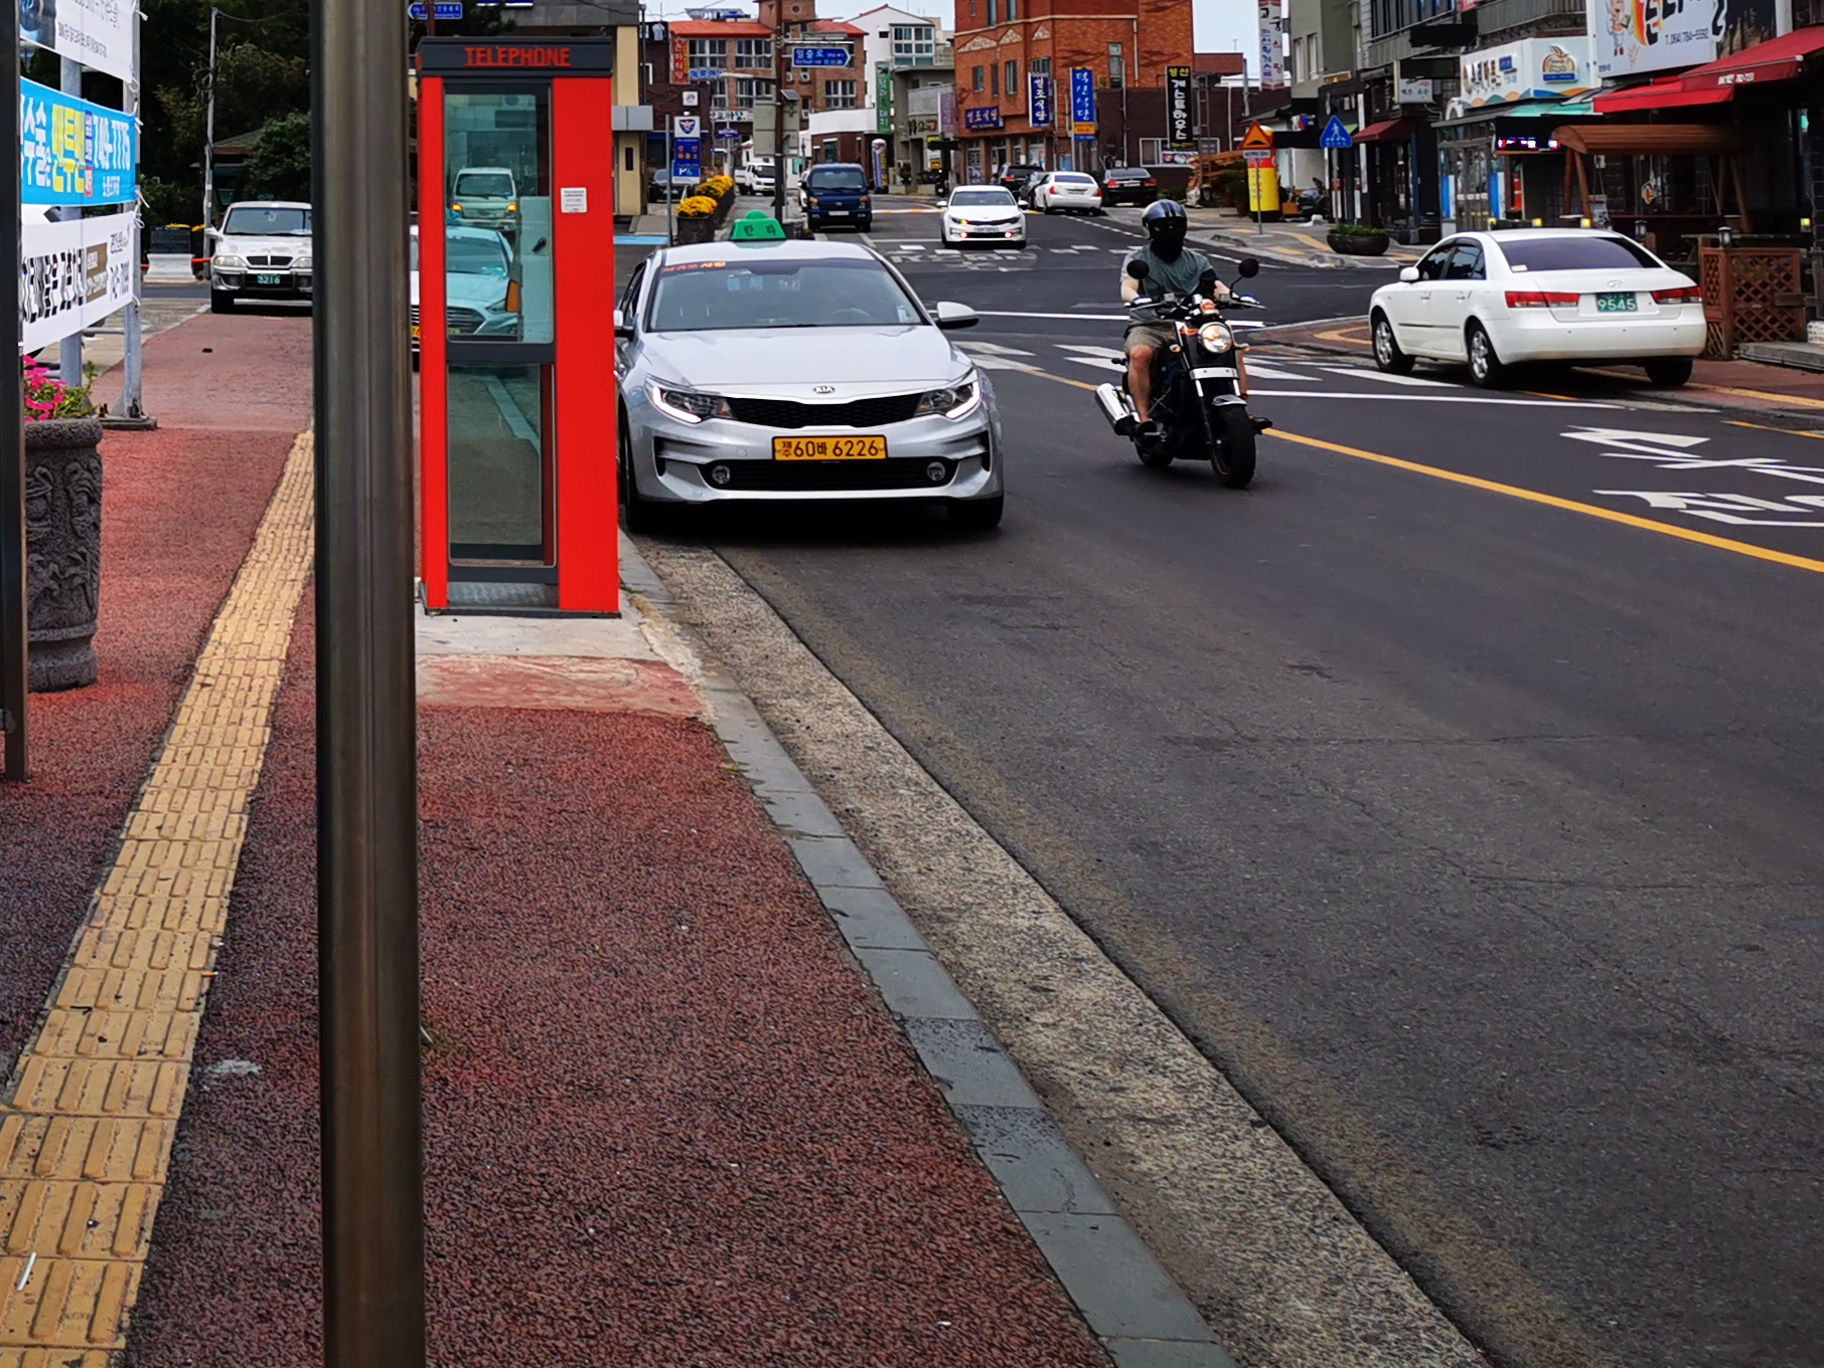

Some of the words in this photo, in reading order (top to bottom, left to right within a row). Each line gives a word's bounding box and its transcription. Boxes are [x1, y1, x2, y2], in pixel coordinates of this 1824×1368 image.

[463, 47, 572, 68] TELEPHONE
[1597, 298, 1636, 311] 9545
[832, 439, 879, 457] 6226
